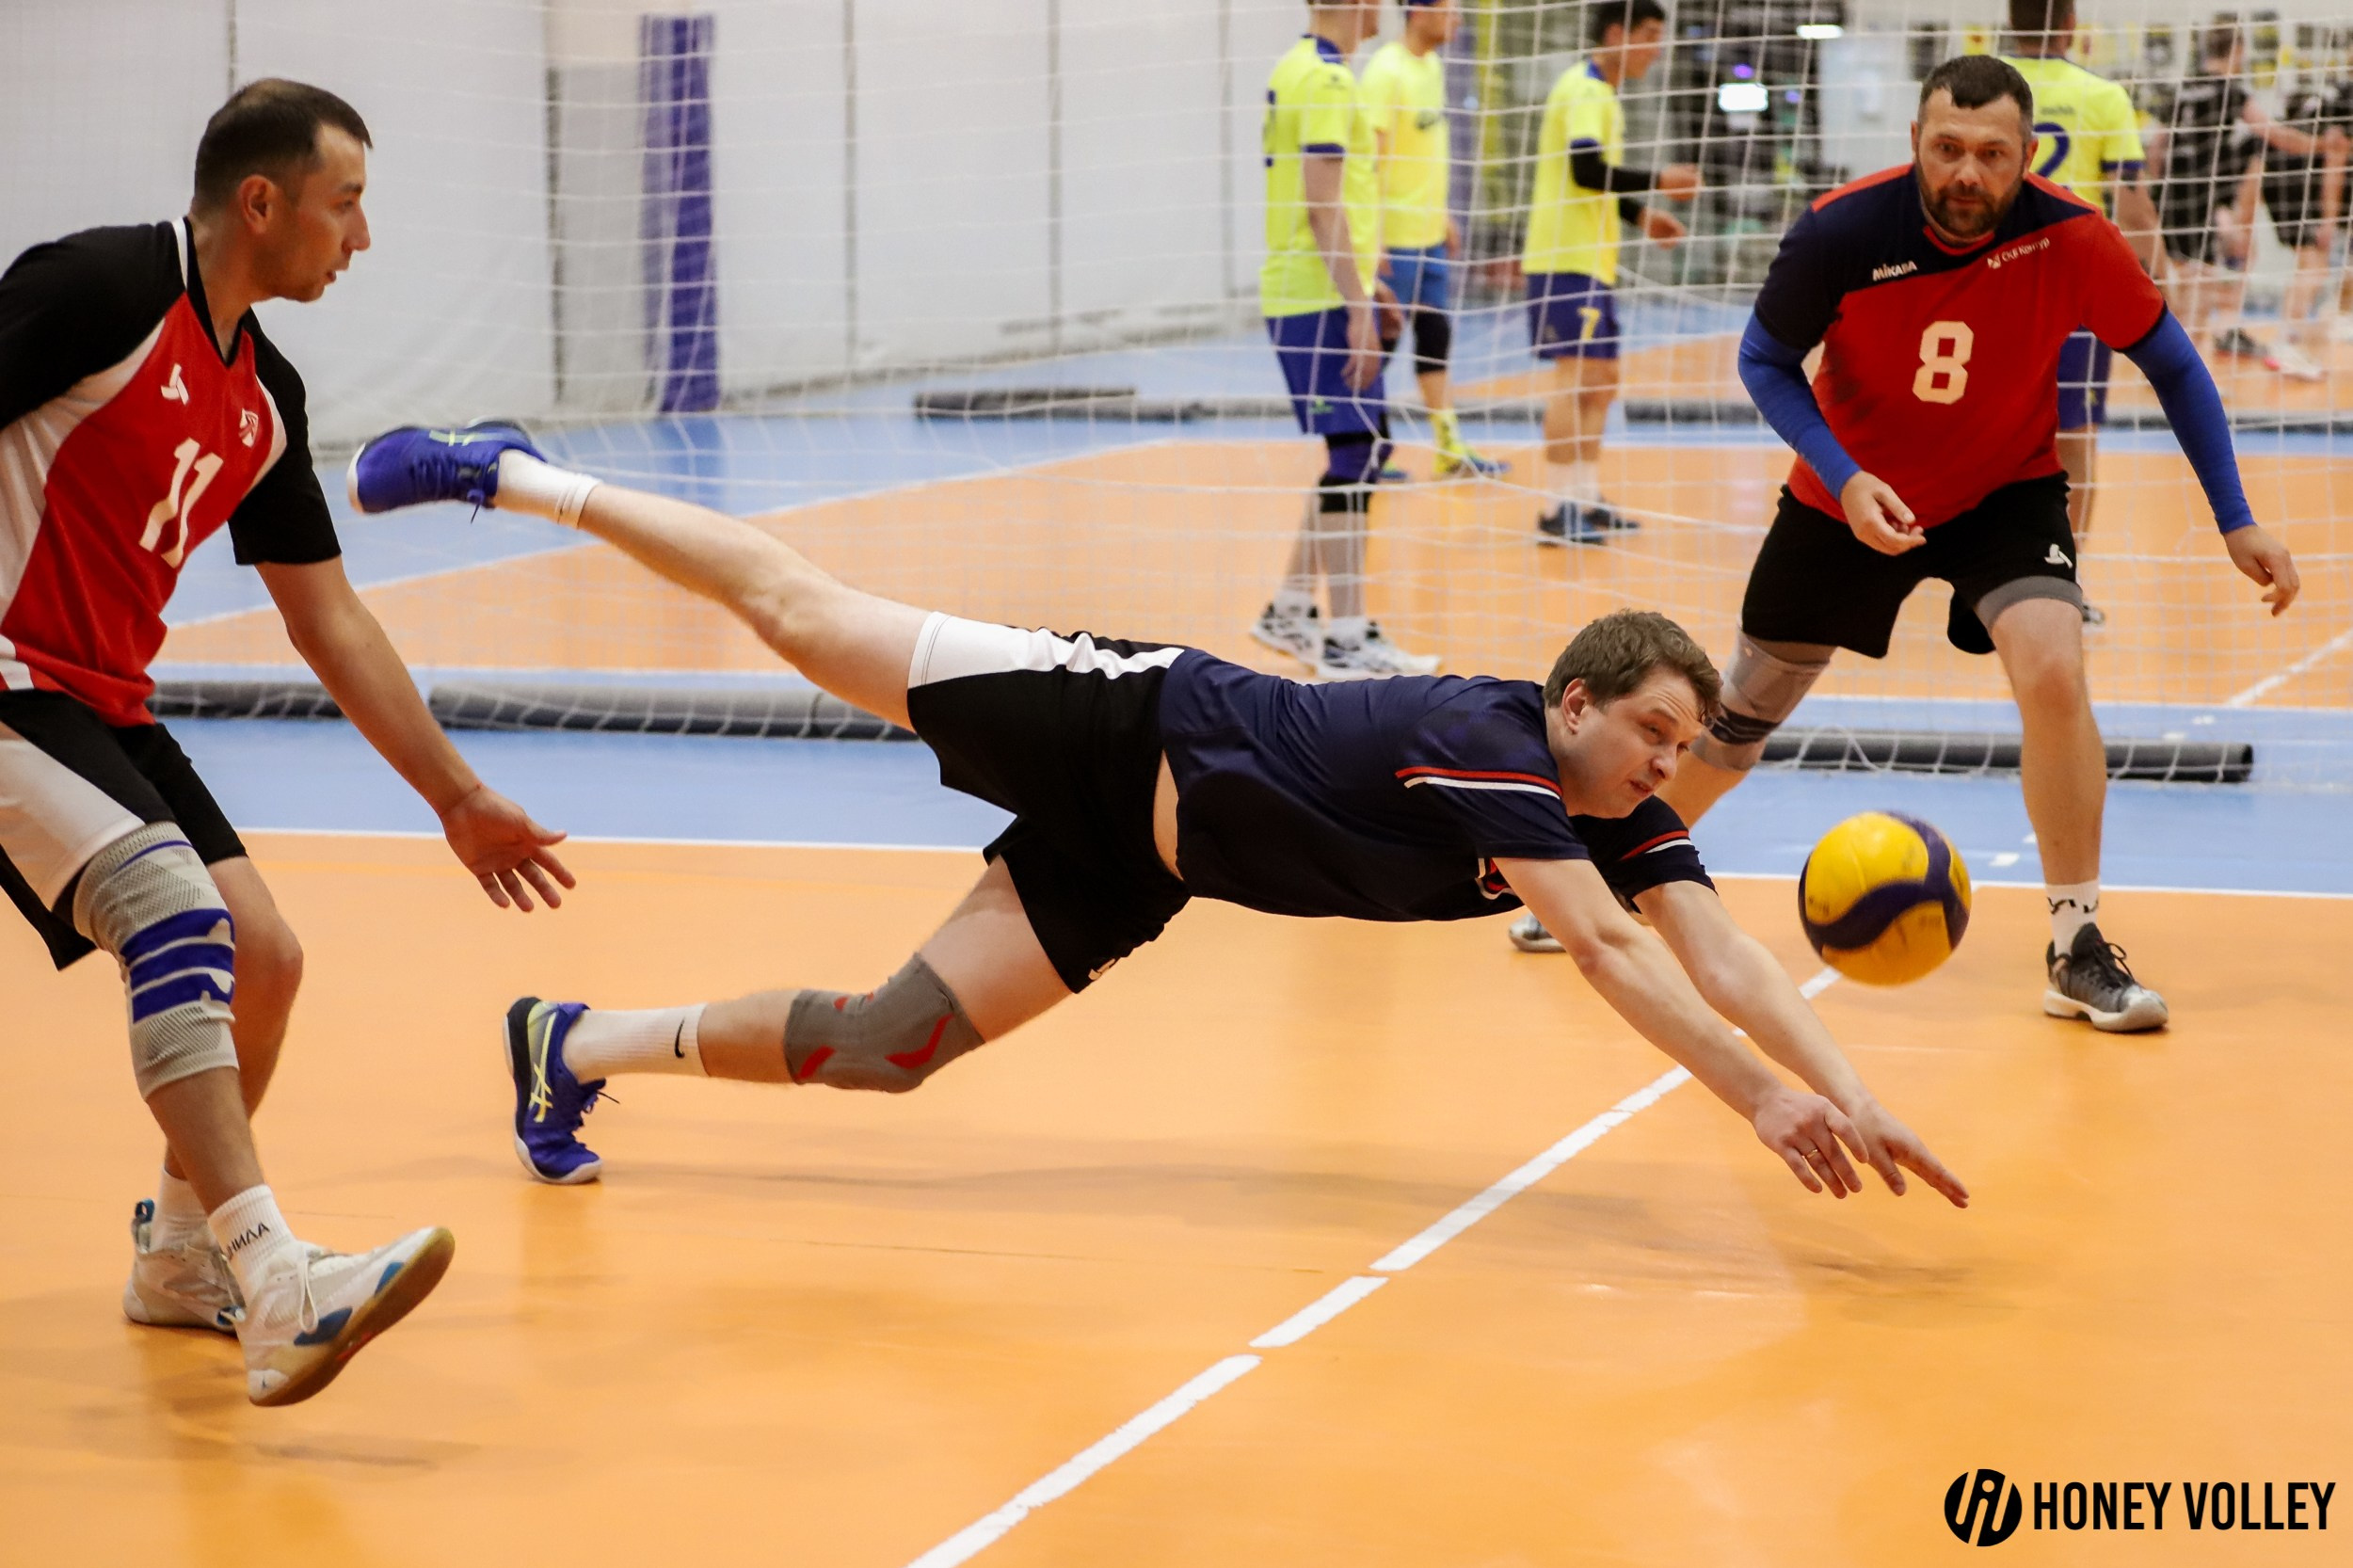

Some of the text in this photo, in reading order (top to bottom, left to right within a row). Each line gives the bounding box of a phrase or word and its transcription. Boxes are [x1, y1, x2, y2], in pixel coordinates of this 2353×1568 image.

[2033, 122, 2070, 181] 2
[1577, 306, 1601, 342] 7
[1912, 320, 1975, 405] 8
[138, 437, 224, 569] 11
